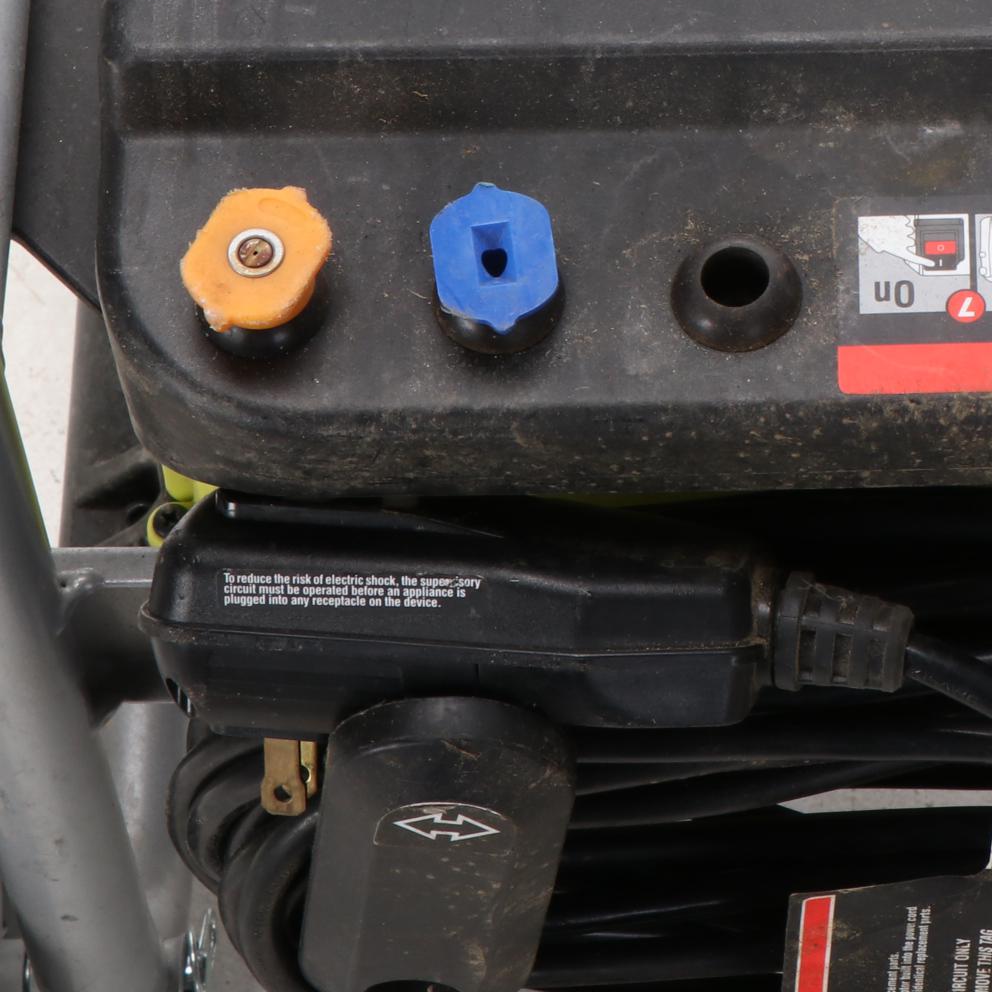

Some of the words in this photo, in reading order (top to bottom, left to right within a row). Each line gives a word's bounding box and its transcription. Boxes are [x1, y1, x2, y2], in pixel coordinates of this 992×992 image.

[874, 280, 914, 308] On
[958, 297, 976, 316] 7
[224, 573, 234, 583] To
[237, 573, 272, 584] reduce
[274, 574, 290, 584] the
[292, 574, 311, 584] risk
[314, 574, 324, 584] of
[325, 575, 364, 585] electric
[366, 575, 399, 586] shock,
[401, 576, 417, 586] the
[224, 584, 256, 594] circuit
[258, 584, 284, 594] must
[287, 584, 300, 594] be
[303, 585, 348, 597] operated
[351, 586, 384, 596] before
[387, 588, 400, 596] an
[403, 587, 453, 598] appliance
[456, 587, 466, 597] is
[224, 594, 266, 606] plugged
[268, 595, 288, 605] into
[291, 596, 309, 607] any
[312, 595, 366, 608] receptacle
[369, 598, 382, 606] on
[384, 597, 401, 606] the
[404, 597, 441, 607] device.
[906, 906, 917, 921] cord
[903, 942, 913, 951] the
[916, 925, 928, 964] replacement
[954, 938, 970, 960] ONLY
[901, 952, 913, 964] into
[977, 947, 992, 966] THIS
